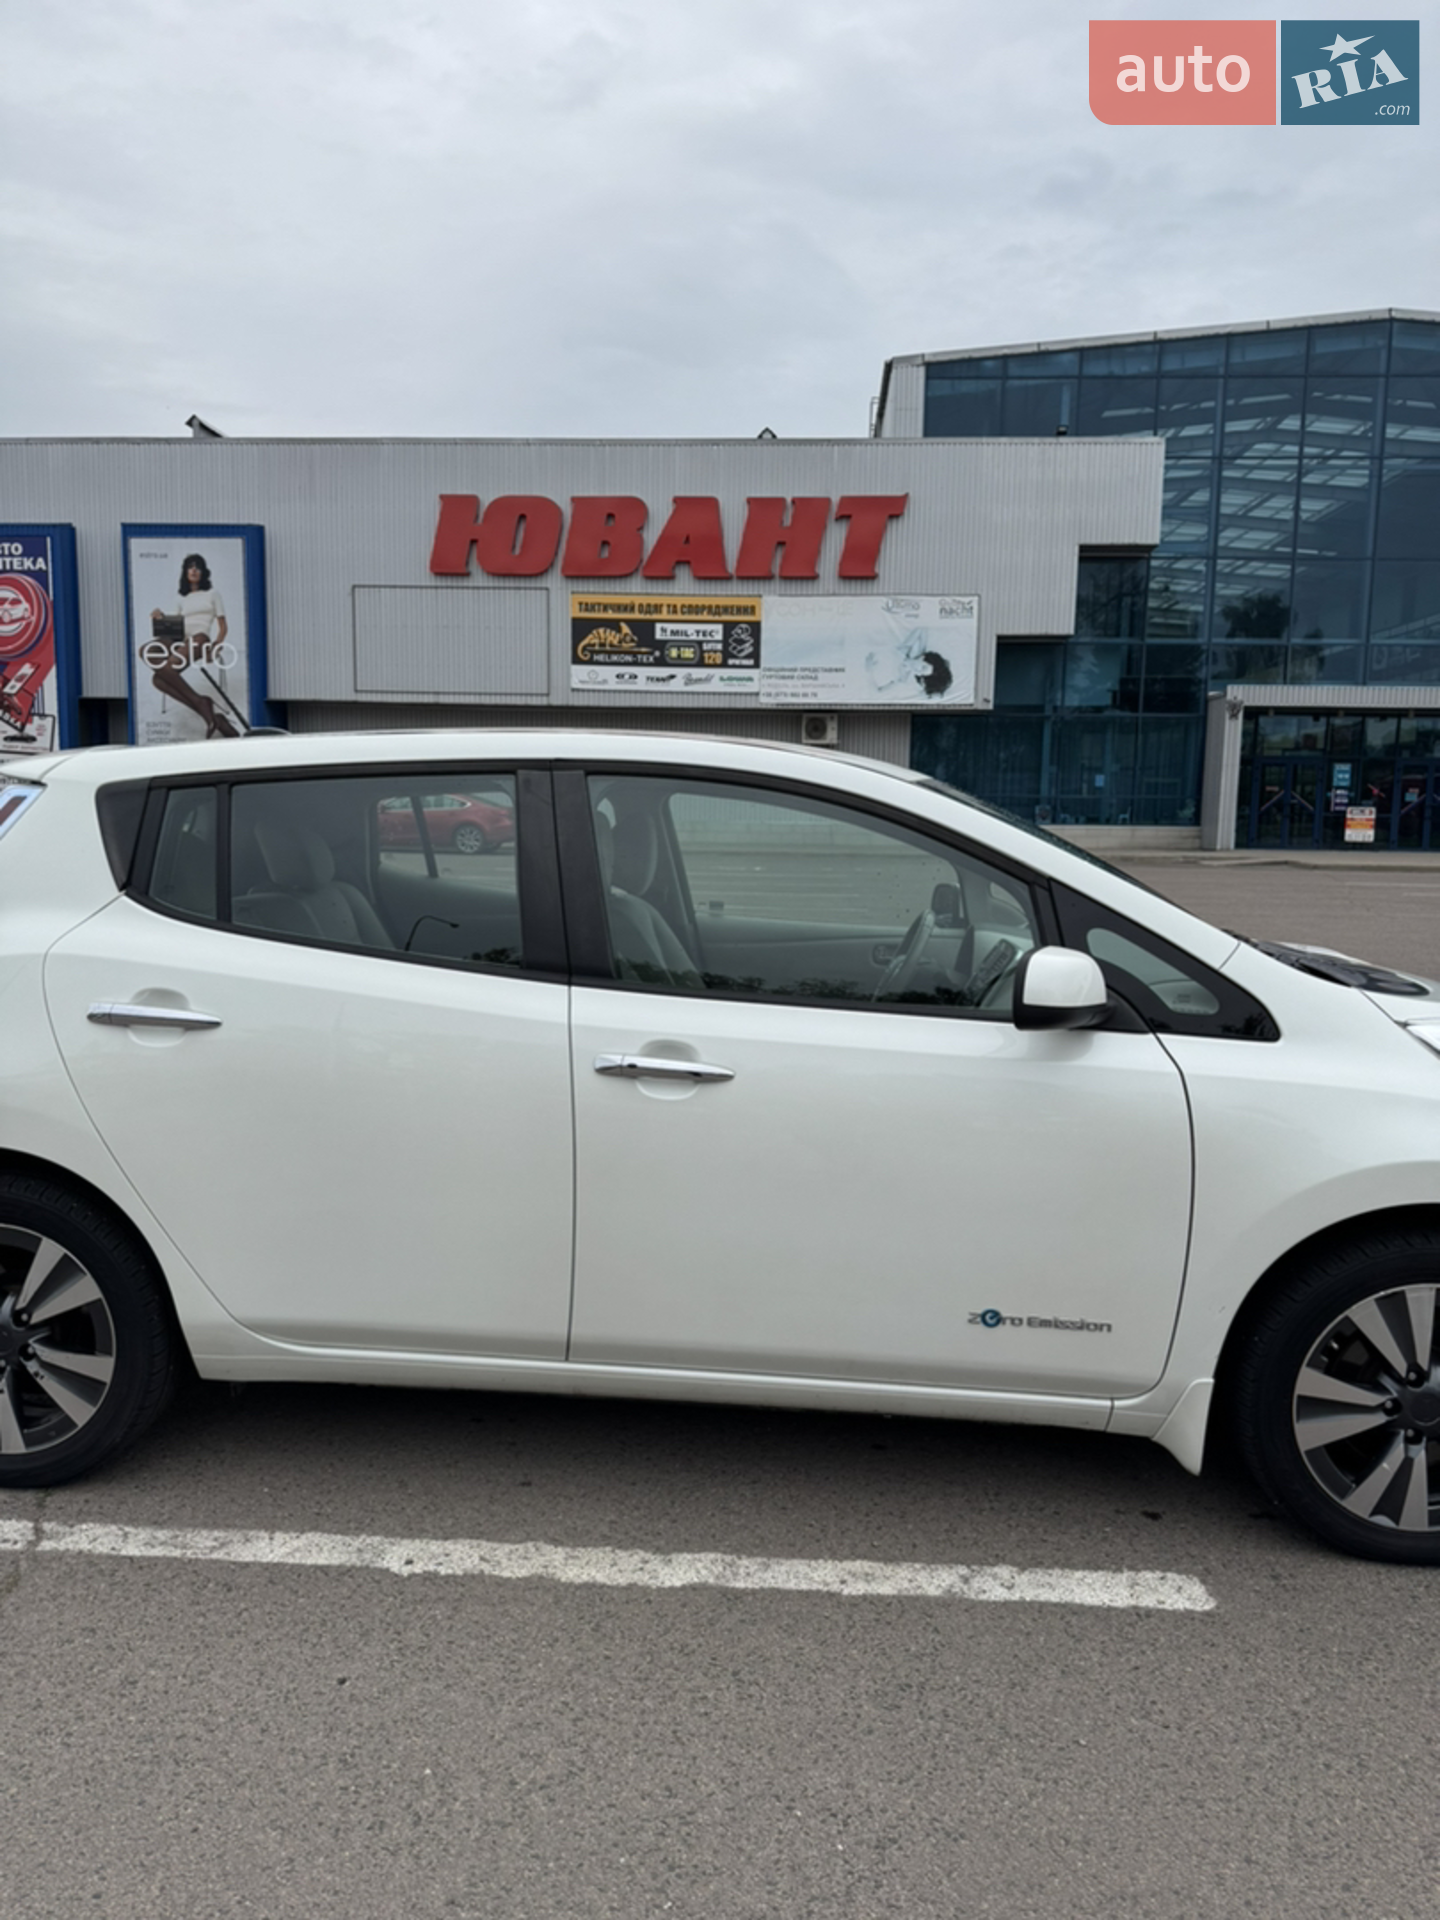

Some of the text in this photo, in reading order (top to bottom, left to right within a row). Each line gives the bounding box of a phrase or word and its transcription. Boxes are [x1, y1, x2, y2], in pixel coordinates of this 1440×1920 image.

[429, 493, 909, 580] ЮВАНТ
[0, 542, 23, 555] ТО
[578, 601, 756, 617] ТАКТИЧНИЙ ОДЯГ ТА СПОРЯДЖЕННЯ
[143, 637, 239, 670] estro
[1027, 1316, 1112, 1333] Emission
